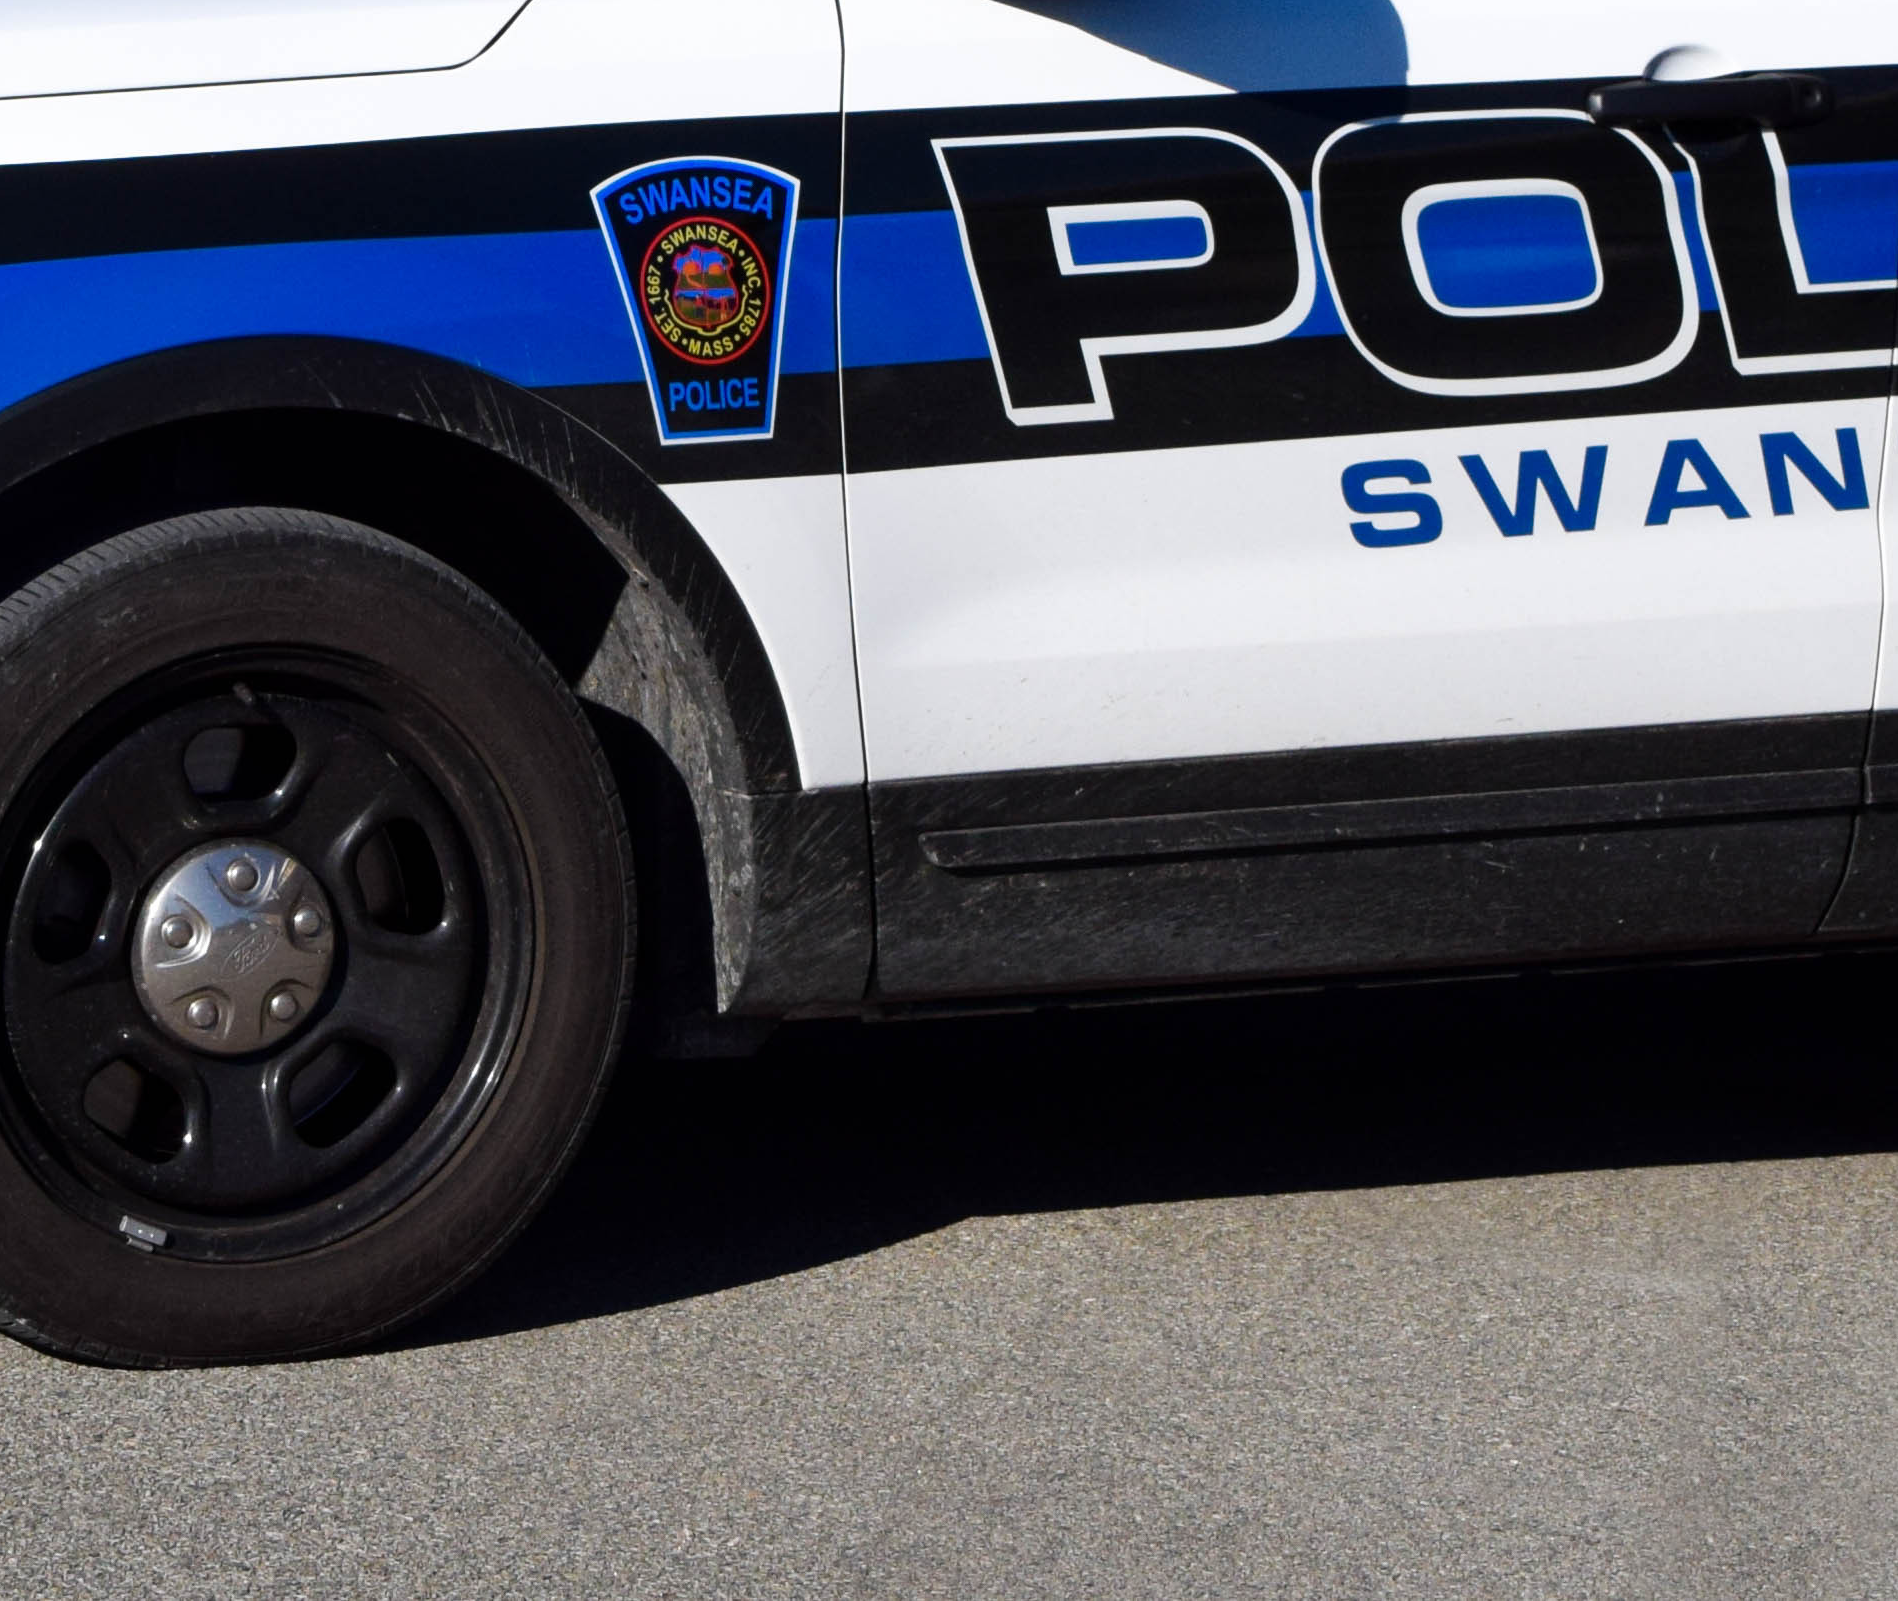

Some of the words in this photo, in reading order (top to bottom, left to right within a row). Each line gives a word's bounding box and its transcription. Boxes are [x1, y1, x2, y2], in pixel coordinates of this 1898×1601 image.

[619, 175, 773, 225] SWANSEA
[660, 224, 739, 255] SWANSEA
[647, 264, 662, 305] 1667
[740, 255, 762, 294] INC.
[653, 307, 683, 343] SET.
[738, 297, 762, 337] 1785
[688, 337, 734, 358] MASS
[668, 376, 760, 412] POLICE
[233, 933, 272, 975] Ford
